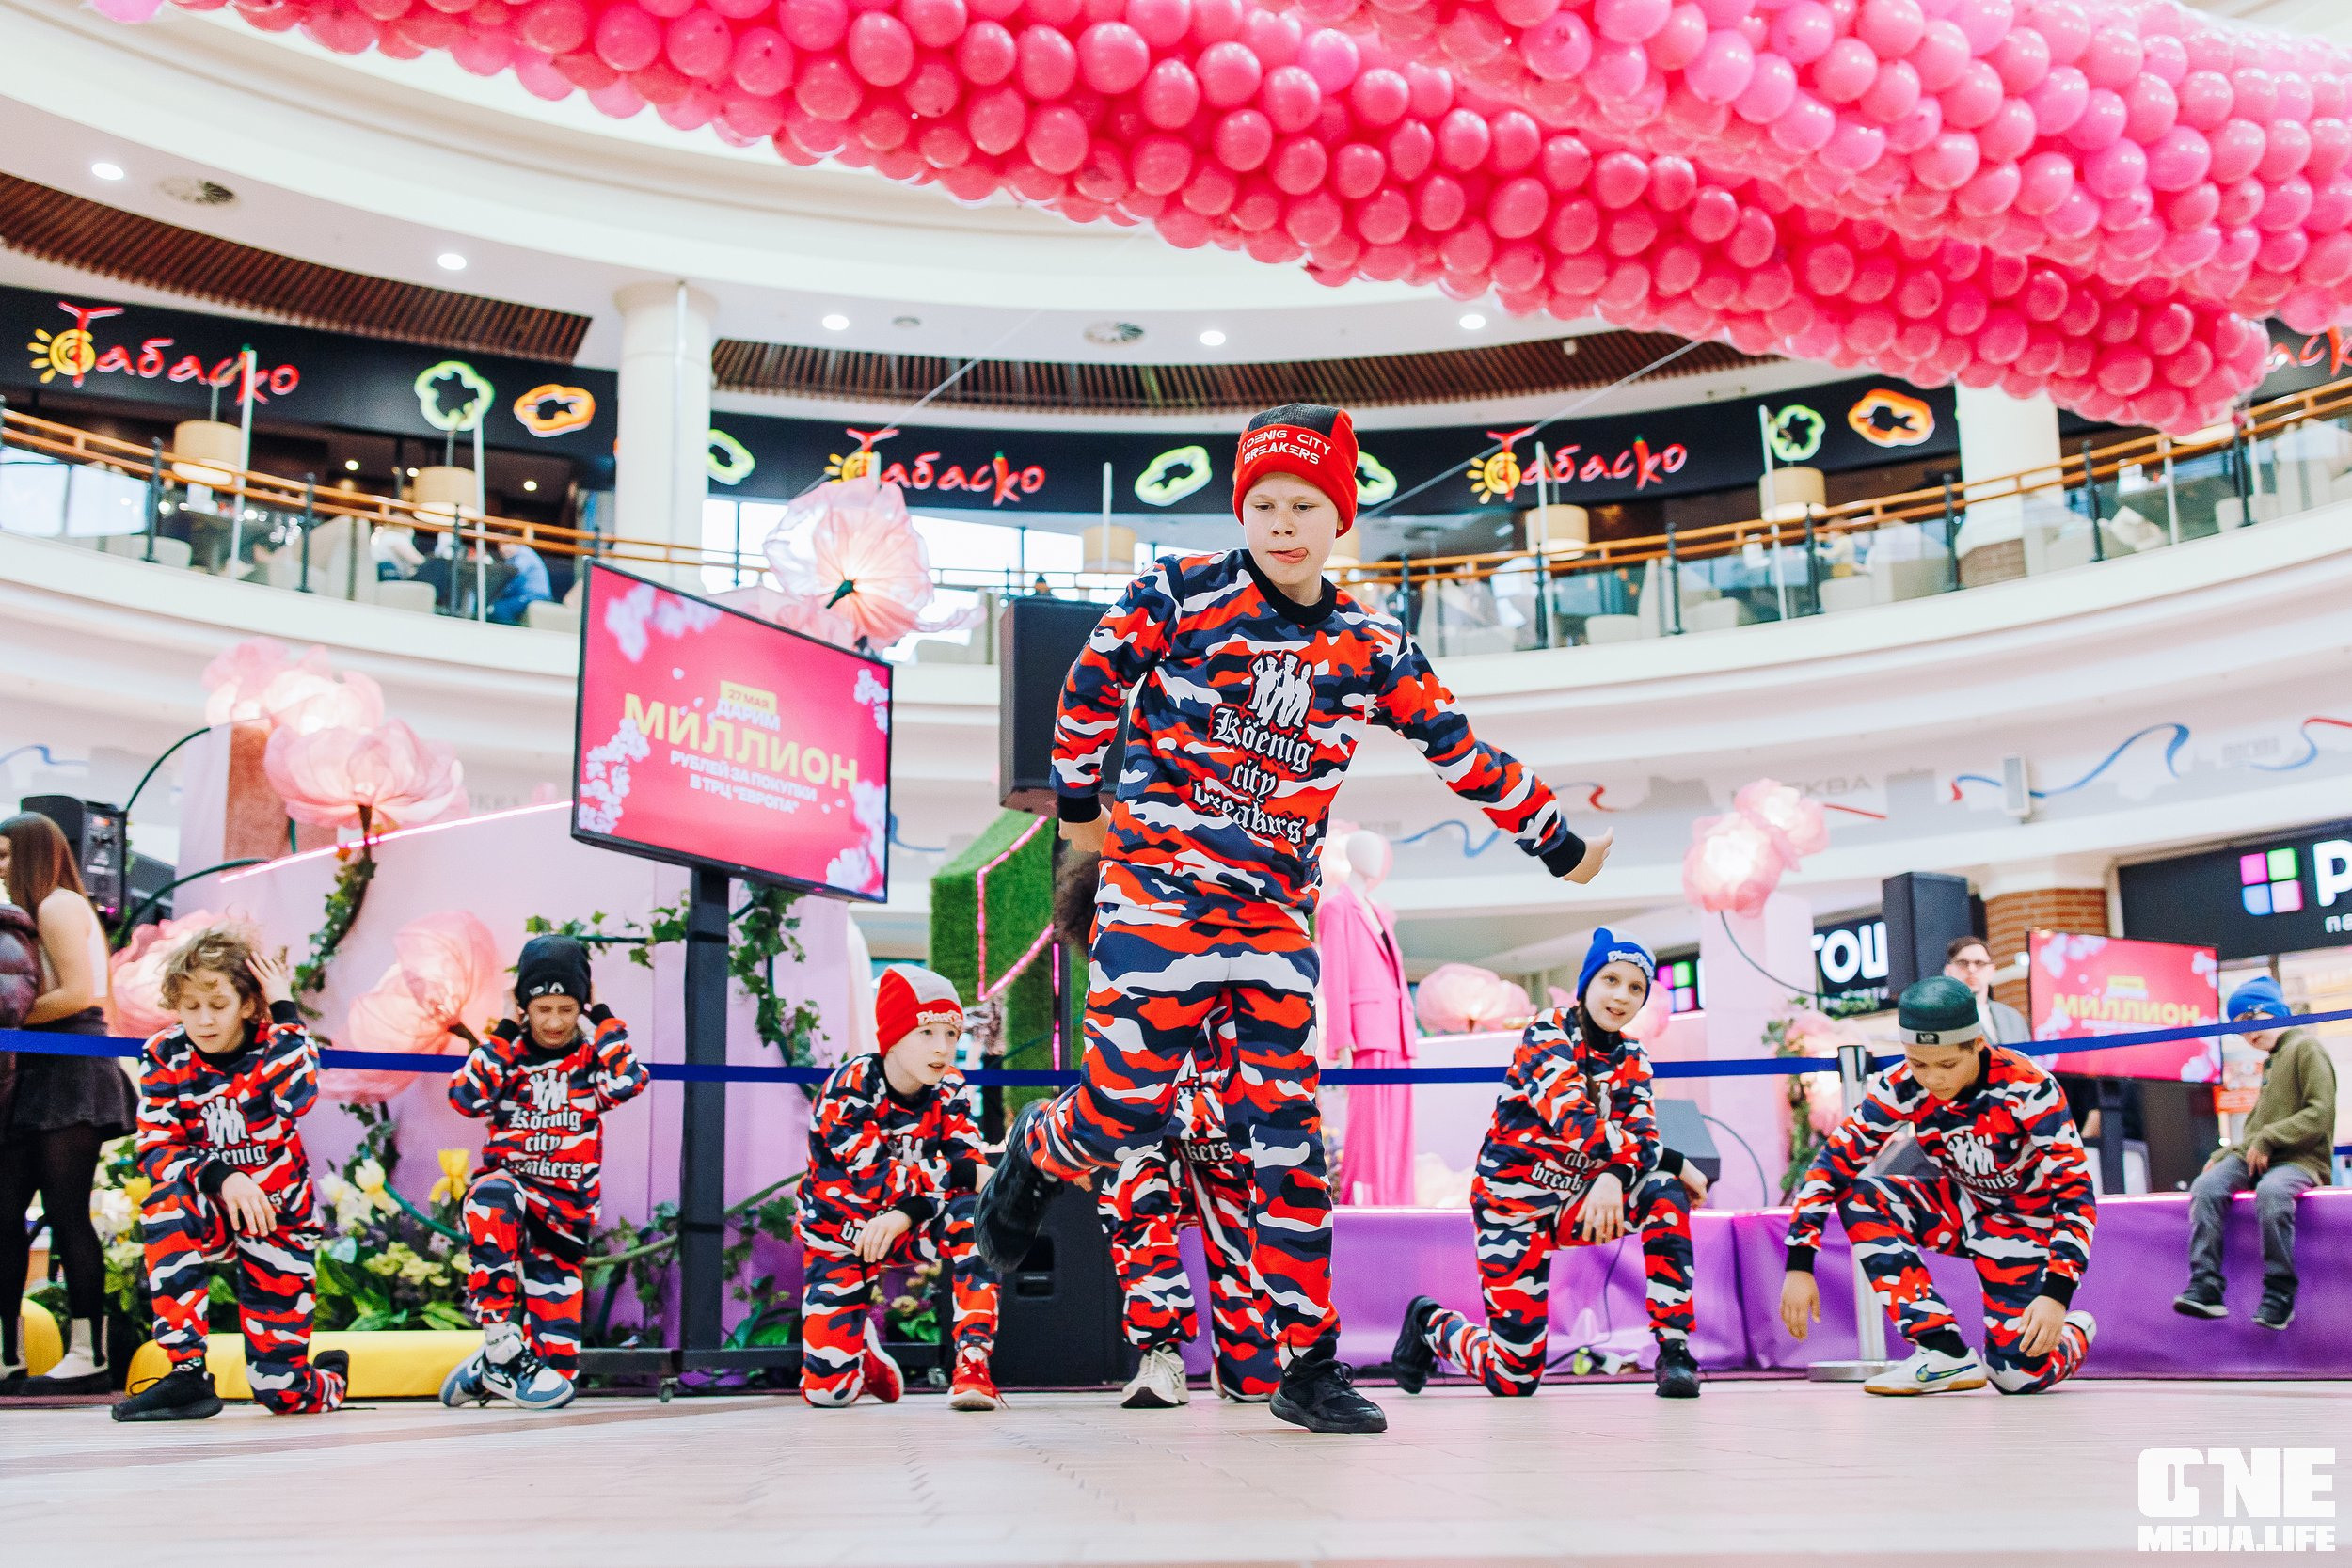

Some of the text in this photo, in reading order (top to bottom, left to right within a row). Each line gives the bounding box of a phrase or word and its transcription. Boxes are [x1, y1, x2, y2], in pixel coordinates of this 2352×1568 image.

[58, 301, 300, 405] Табаско
[1243, 442, 1321, 465] BREAKERS
[1296, 434, 1331, 455] CITY
[1486, 426, 1688, 503] Табаско
[716, 698, 781, 731] ДАРИМ
[625, 692, 858, 793] МИЛЛИОН
[670, 750, 818, 801] РУБЛЕЙ ЗА ПОКУПКИ
[690, 774, 702, 789] В
[703, 777, 732, 800] ТРЦ
[1232, 759, 1277, 802] city
[2053, 993, 2200, 1026] МИЛЛИОН
[525, 1132, 561, 1155] city
